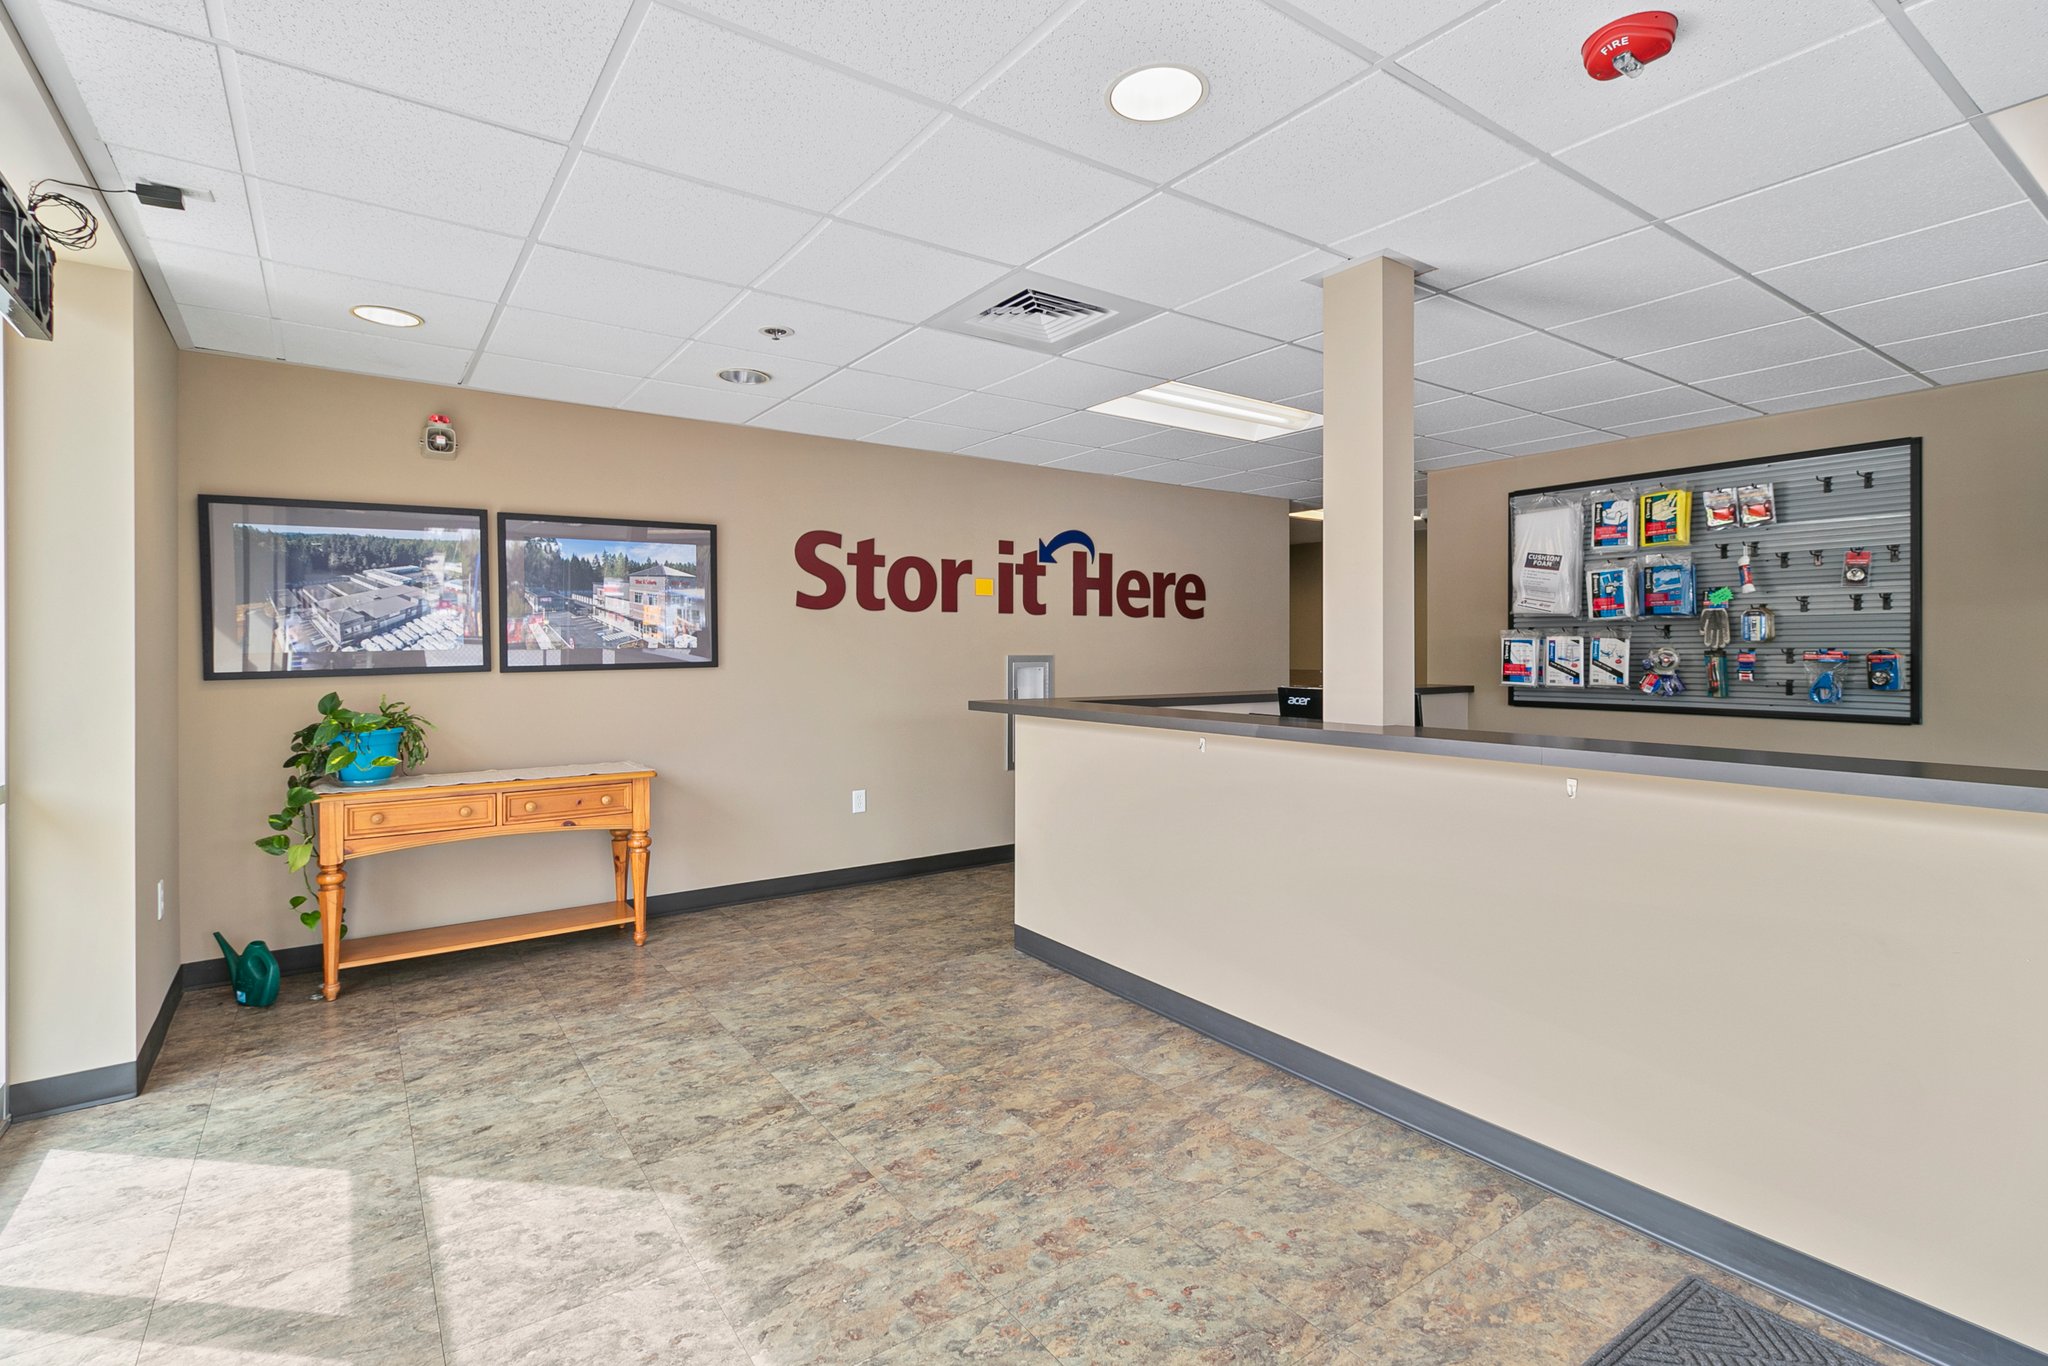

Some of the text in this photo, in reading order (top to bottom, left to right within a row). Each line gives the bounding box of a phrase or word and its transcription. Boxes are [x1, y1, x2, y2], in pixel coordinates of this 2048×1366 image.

[1600, 36, 1629, 55] FIRE
[1528, 554, 1560, 562] CUSHION
[1072, 550, 1207, 620] Here
[1287, 696, 1311, 706] acer
